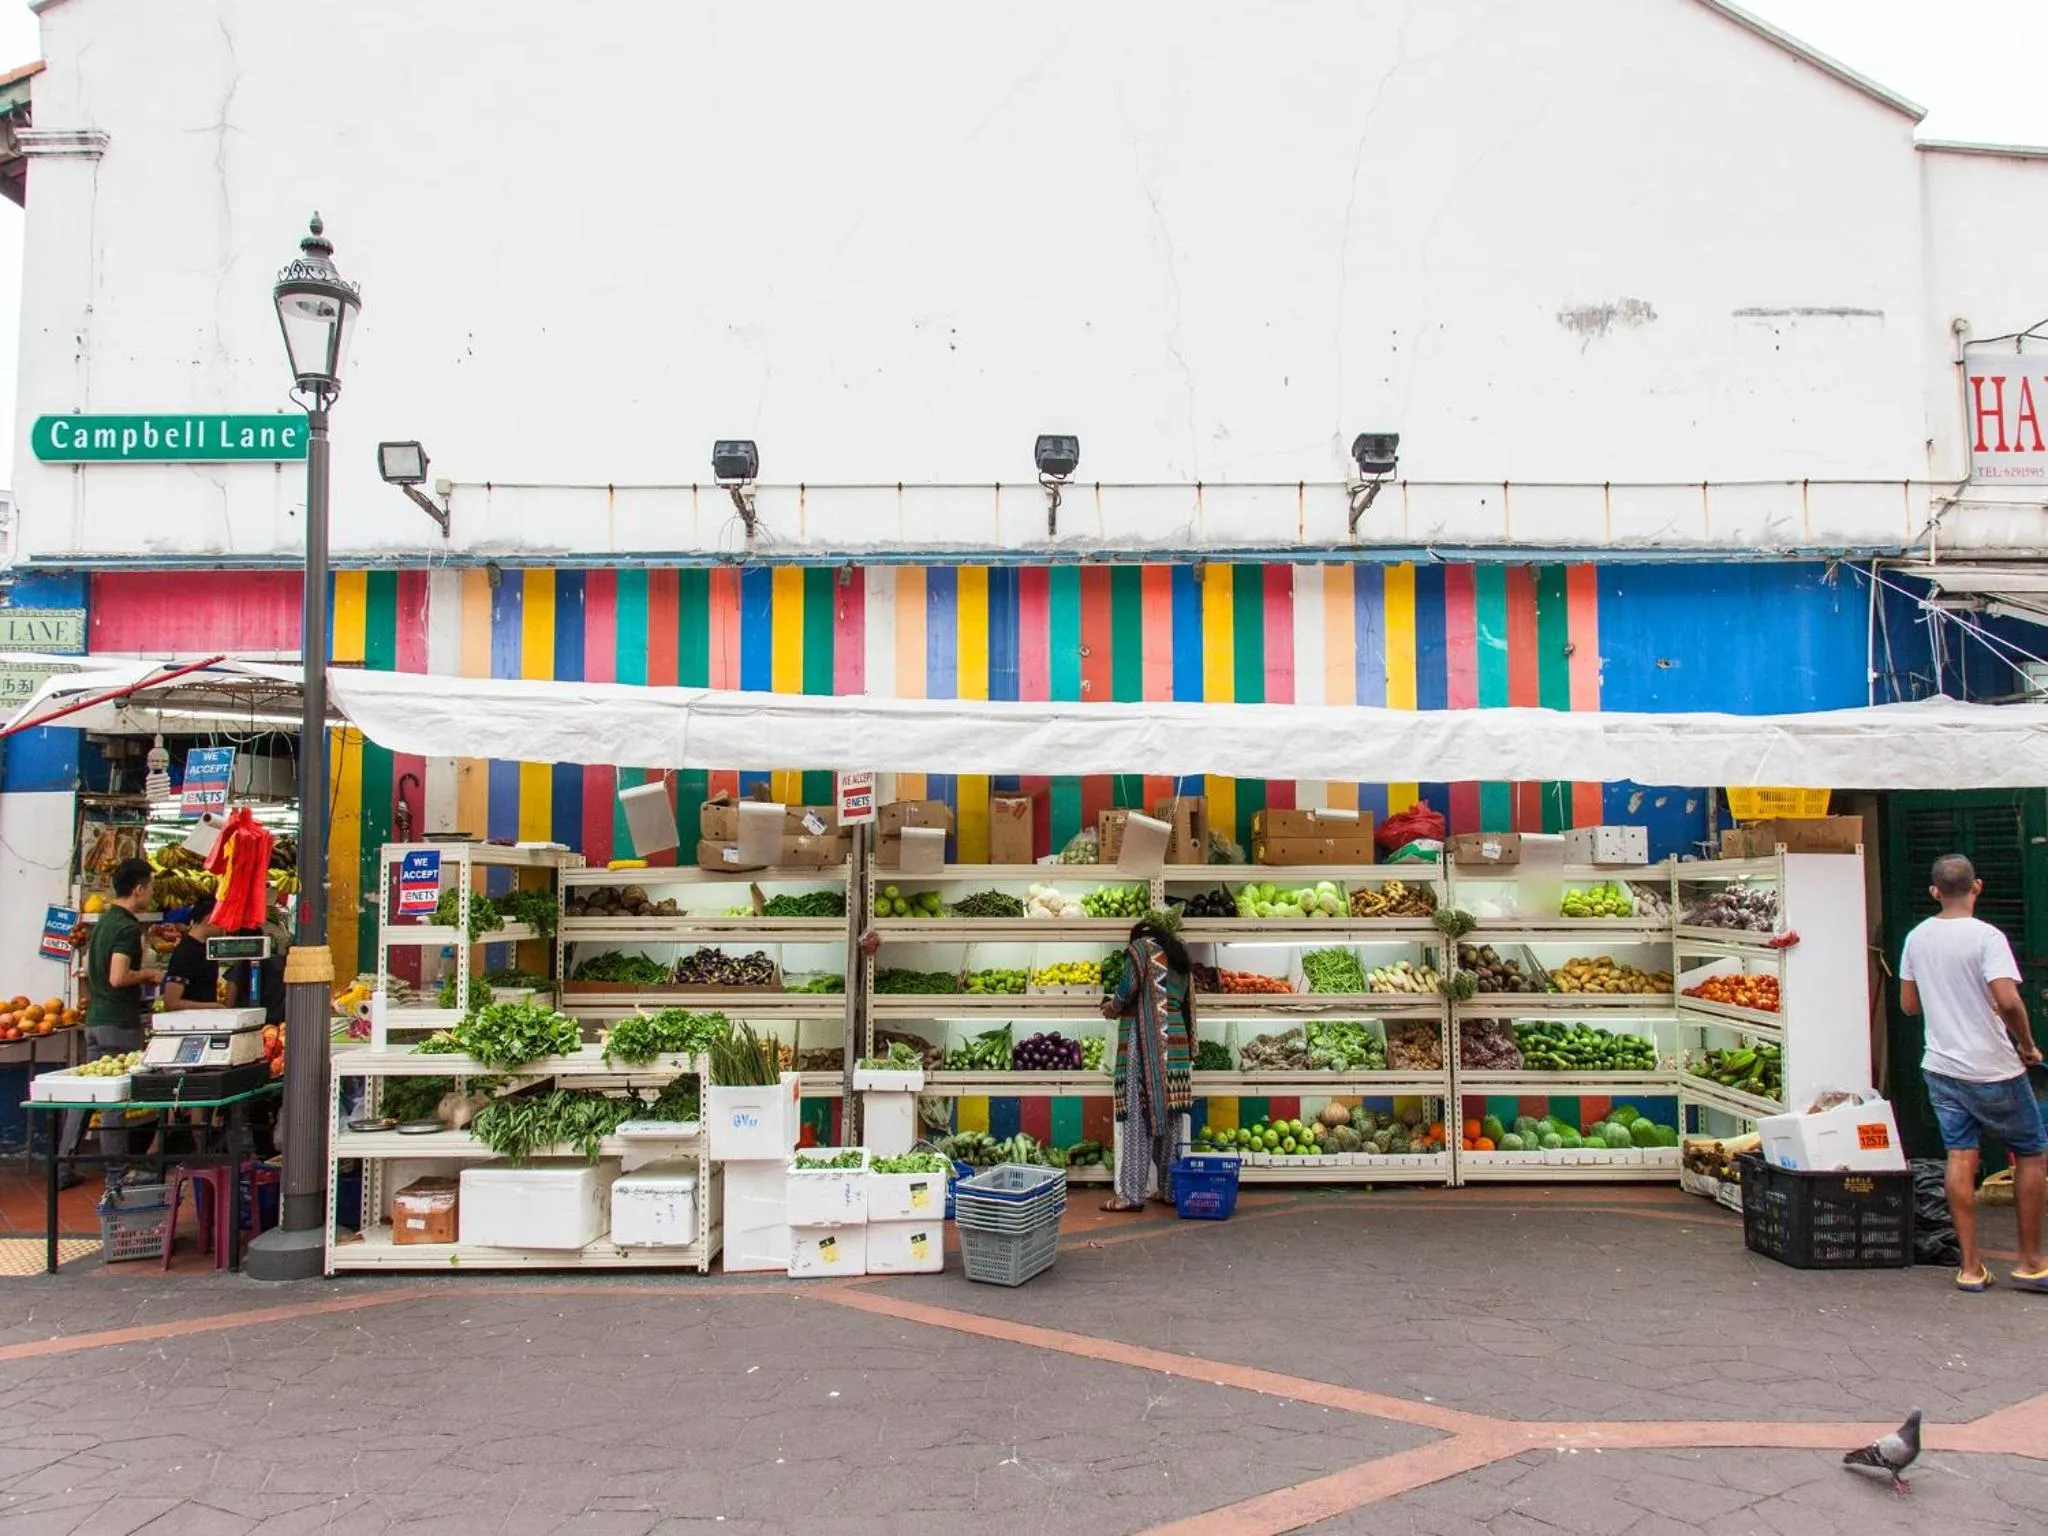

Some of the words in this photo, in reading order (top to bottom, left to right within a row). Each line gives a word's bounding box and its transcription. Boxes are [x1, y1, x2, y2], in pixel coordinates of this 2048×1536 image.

[1970, 376, 2048, 452] HA
[51, 420, 204, 455] Campbell
[220, 420, 296, 449] Lane
[9, 620, 69, 641] LANE
[203, 751, 219, 761] WE
[189, 764, 229, 775] ACCEPT
[413, 857, 429, 867] WE
[402, 870, 439, 880] ACCEPT
[46, 920, 74, 931] ACCEP
